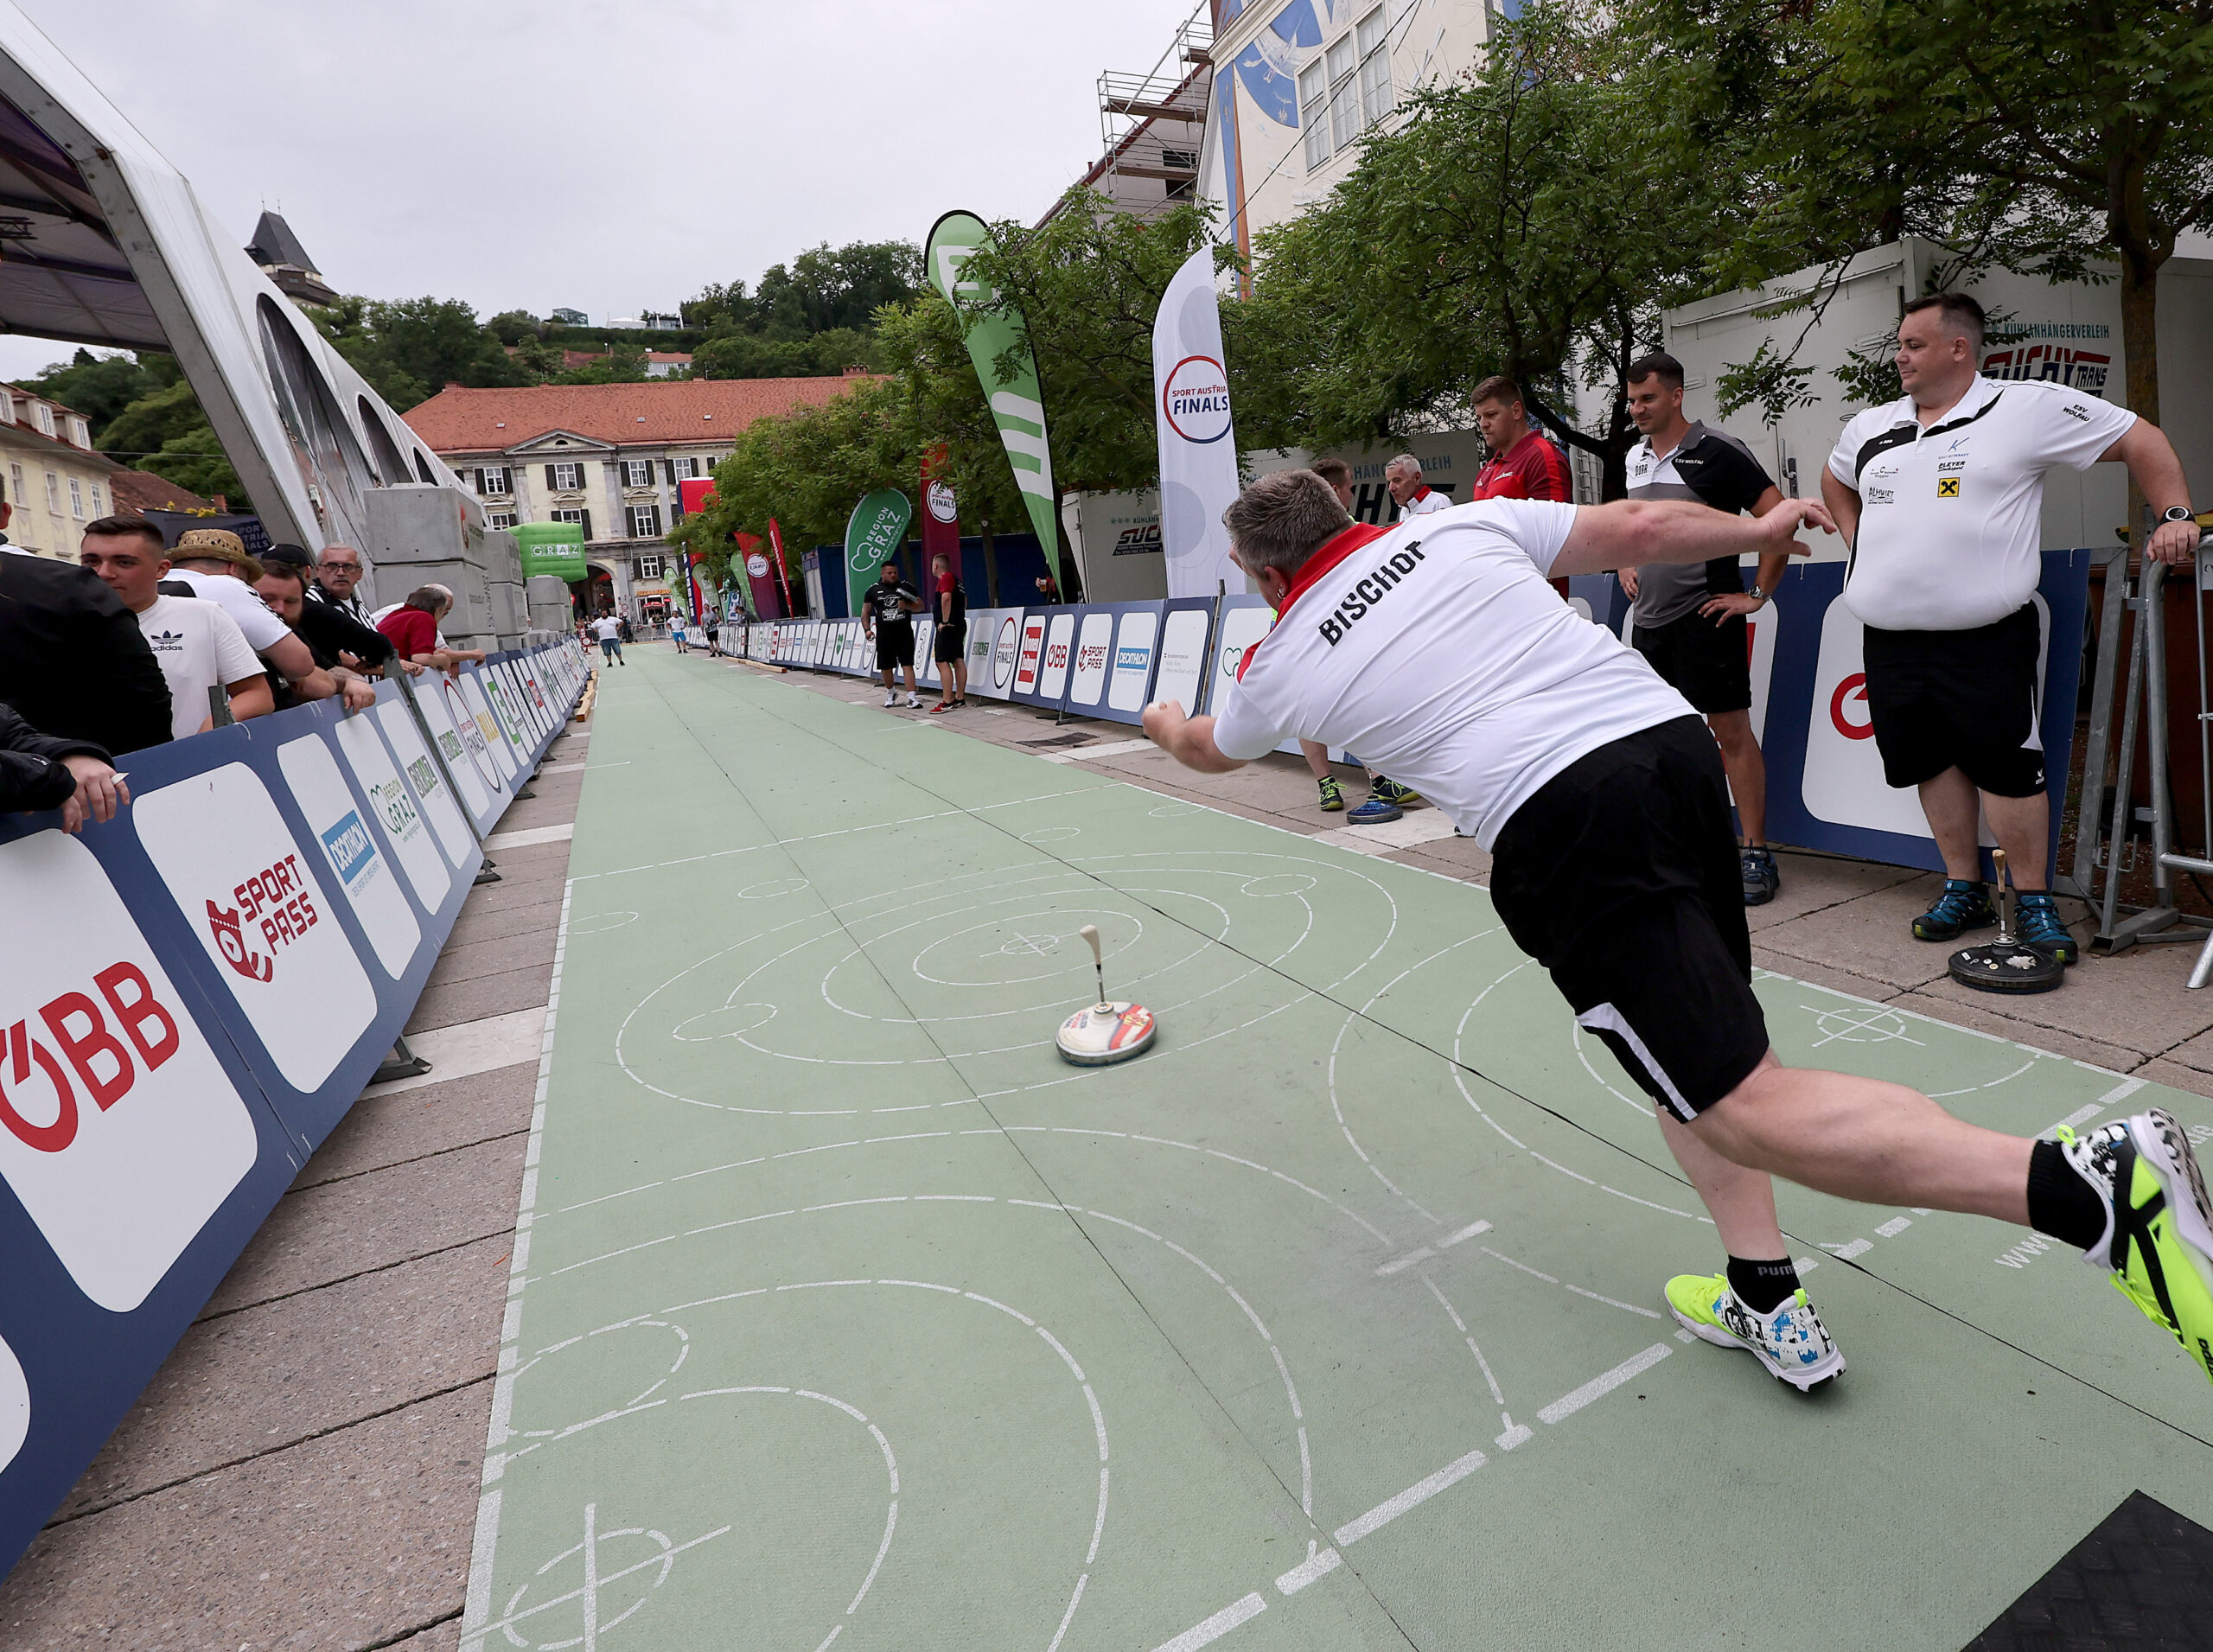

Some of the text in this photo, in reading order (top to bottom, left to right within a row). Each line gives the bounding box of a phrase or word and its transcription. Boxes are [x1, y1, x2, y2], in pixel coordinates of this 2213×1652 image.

[2076, 365, 2109, 387] TRANS
[1172, 385, 1227, 398] SPORT AUSTRIA
[1173, 395, 1228, 415] FINALS
[2063, 406, 2091, 422] WOLFAU
[2073, 404, 2089, 412] ESV
[932, 498, 955, 509] FINALS
[866, 507, 889, 541] REGION
[868, 511, 901, 558] GRAZ
[531, 544, 581, 558] GRAZ
[996, 651, 1013, 664] FINALS
[1048, 644, 1068, 668] ÖBB
[1087, 646, 1106, 657] SPORT
[1119, 652, 1148, 666] DECATHLON
[1087, 658, 1103, 669] PASS
[387, 794, 416, 833] GRAZ
[328, 821, 369, 872] DECATHLON
[233, 853, 303, 922] SPORT
[260, 891, 318, 956] PASS
[0, 961, 180, 1153] ÖBB
[1757, 1265, 1793, 1277] PUM
